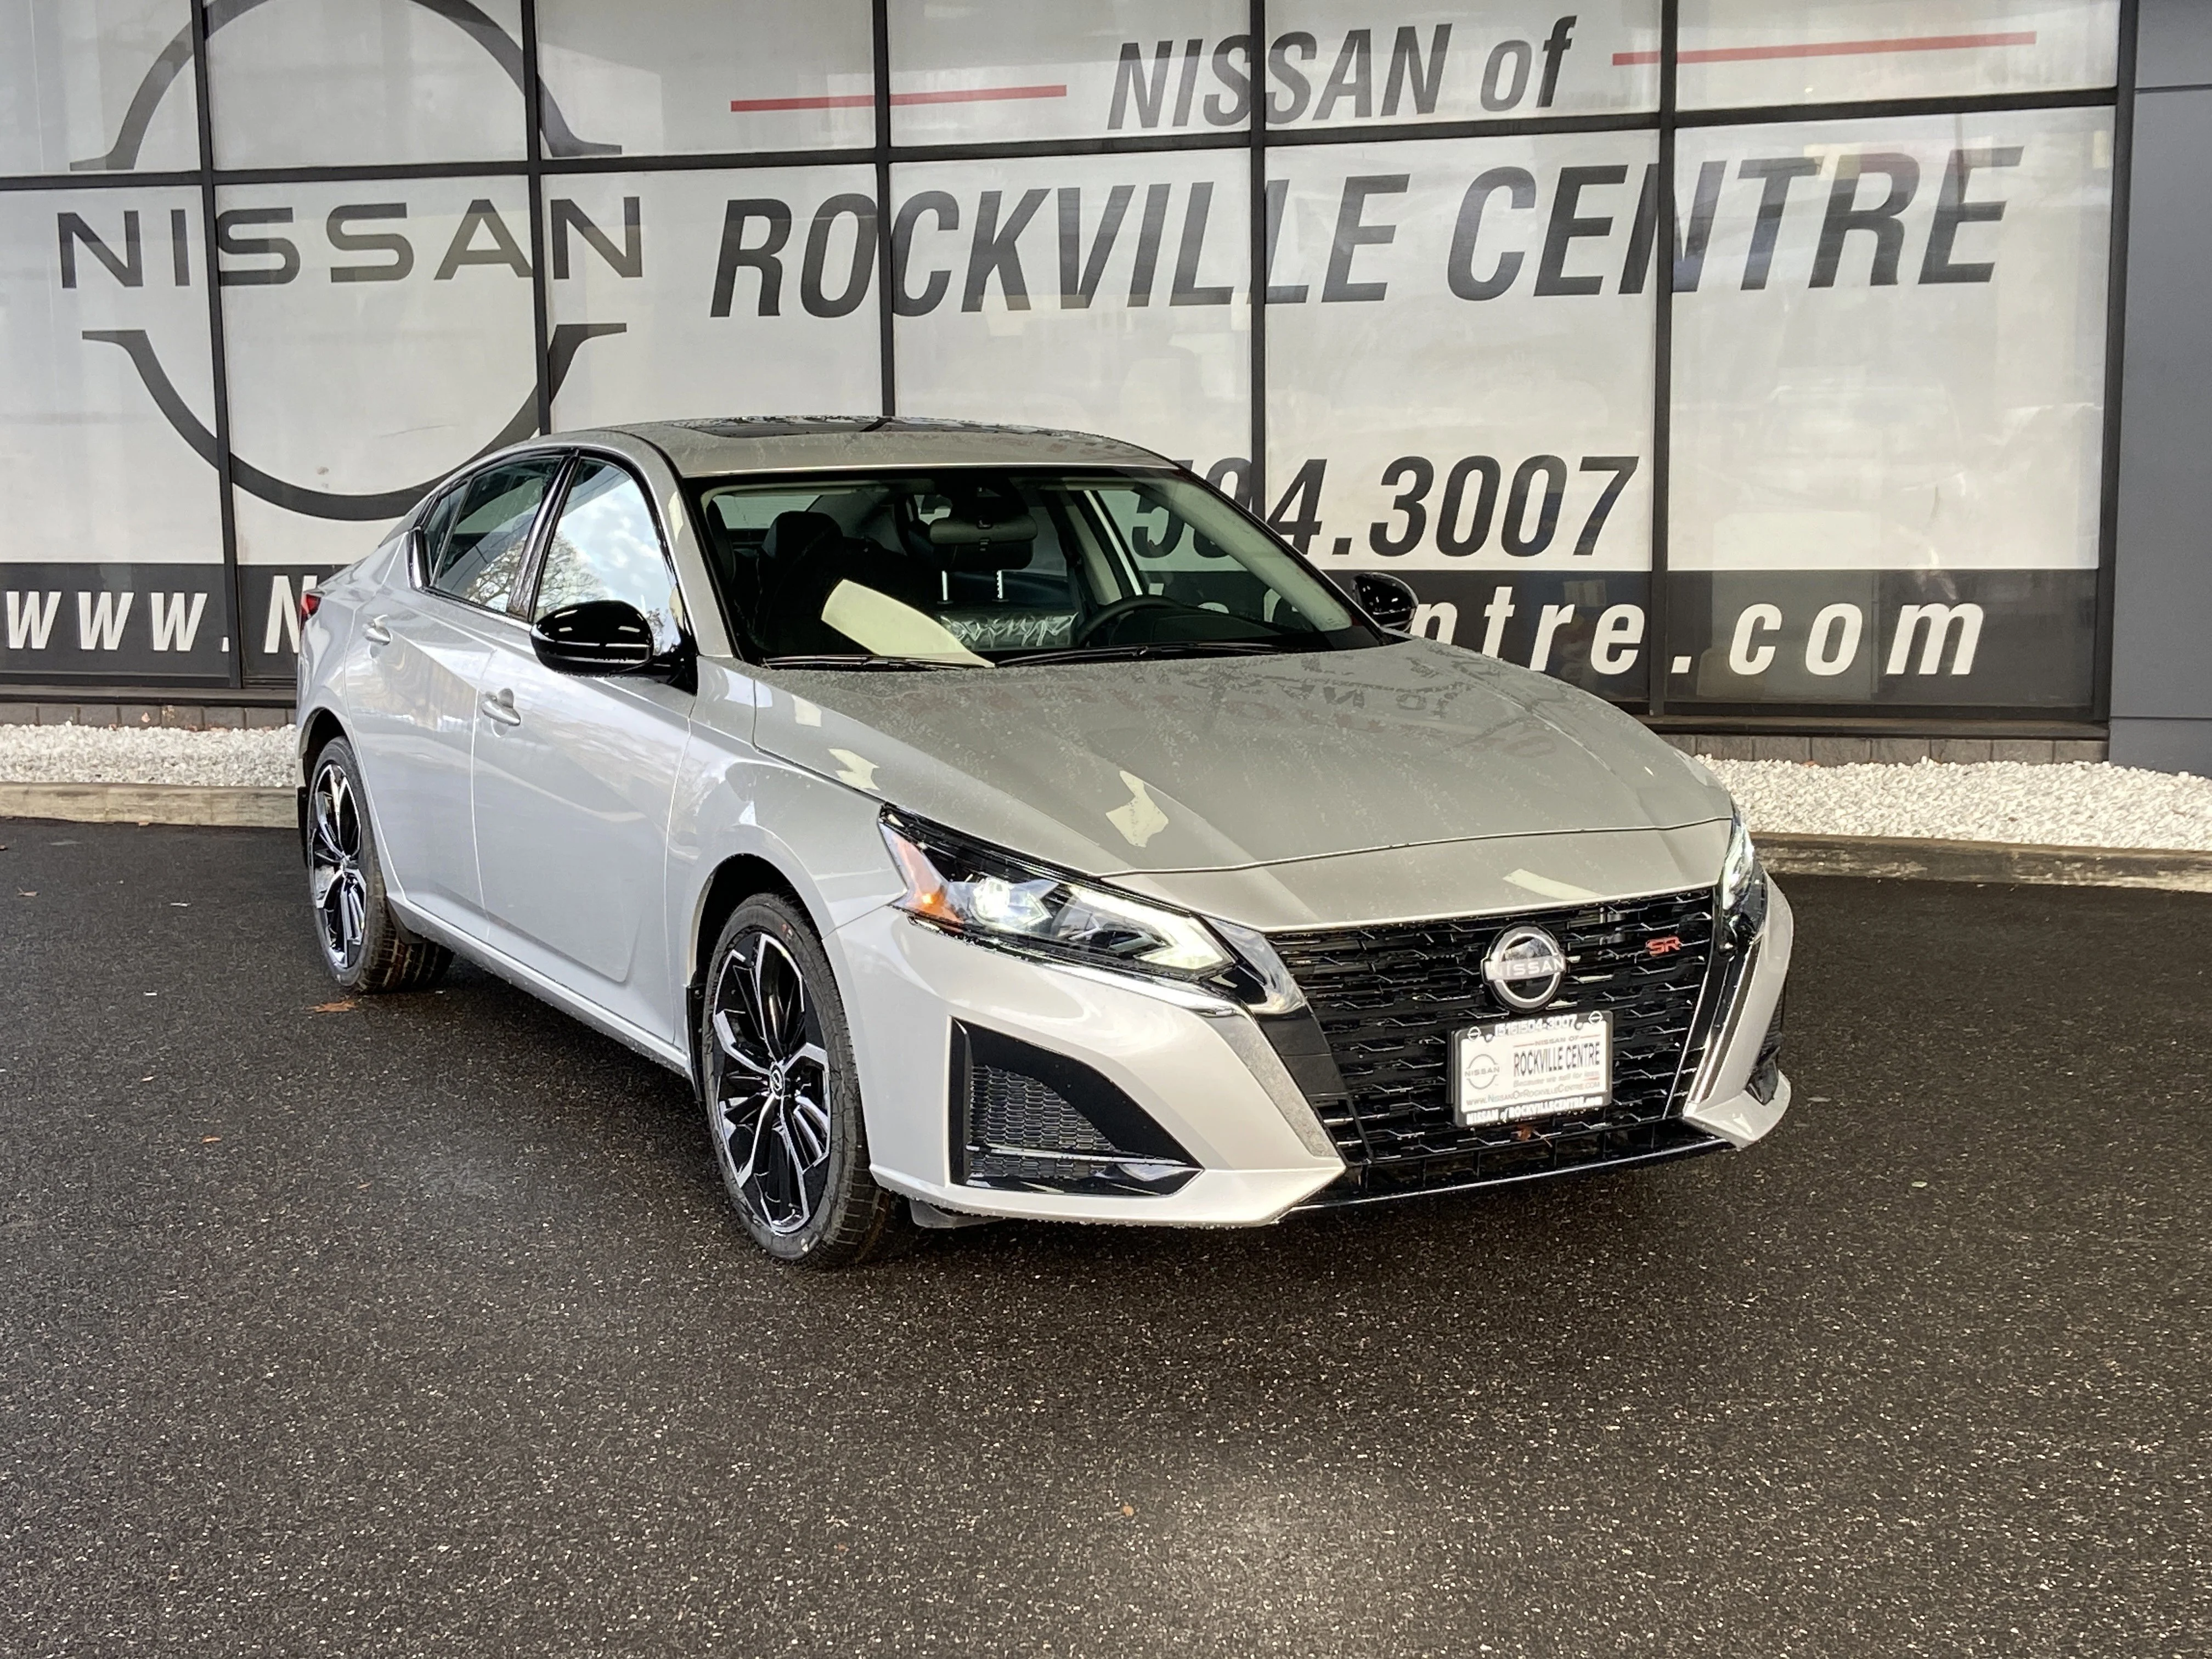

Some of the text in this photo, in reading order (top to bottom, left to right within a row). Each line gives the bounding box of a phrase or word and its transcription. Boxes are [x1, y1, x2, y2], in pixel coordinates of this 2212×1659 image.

[1107, 15, 1578, 131] NISSAN of
[57, 196, 644, 289] NISSAN
[709, 145, 2025, 318] ROCKVILLE CENTRE
[1646, 936, 1680, 957] SR
[1489, 957, 1565, 979] NISSAN
[1464, 1066, 1500, 1077] NISSAN
[1513, 1041, 1600, 1077] ROCKVILLE CENTRE
[1466, 1109, 1499, 1125] NISSAN
